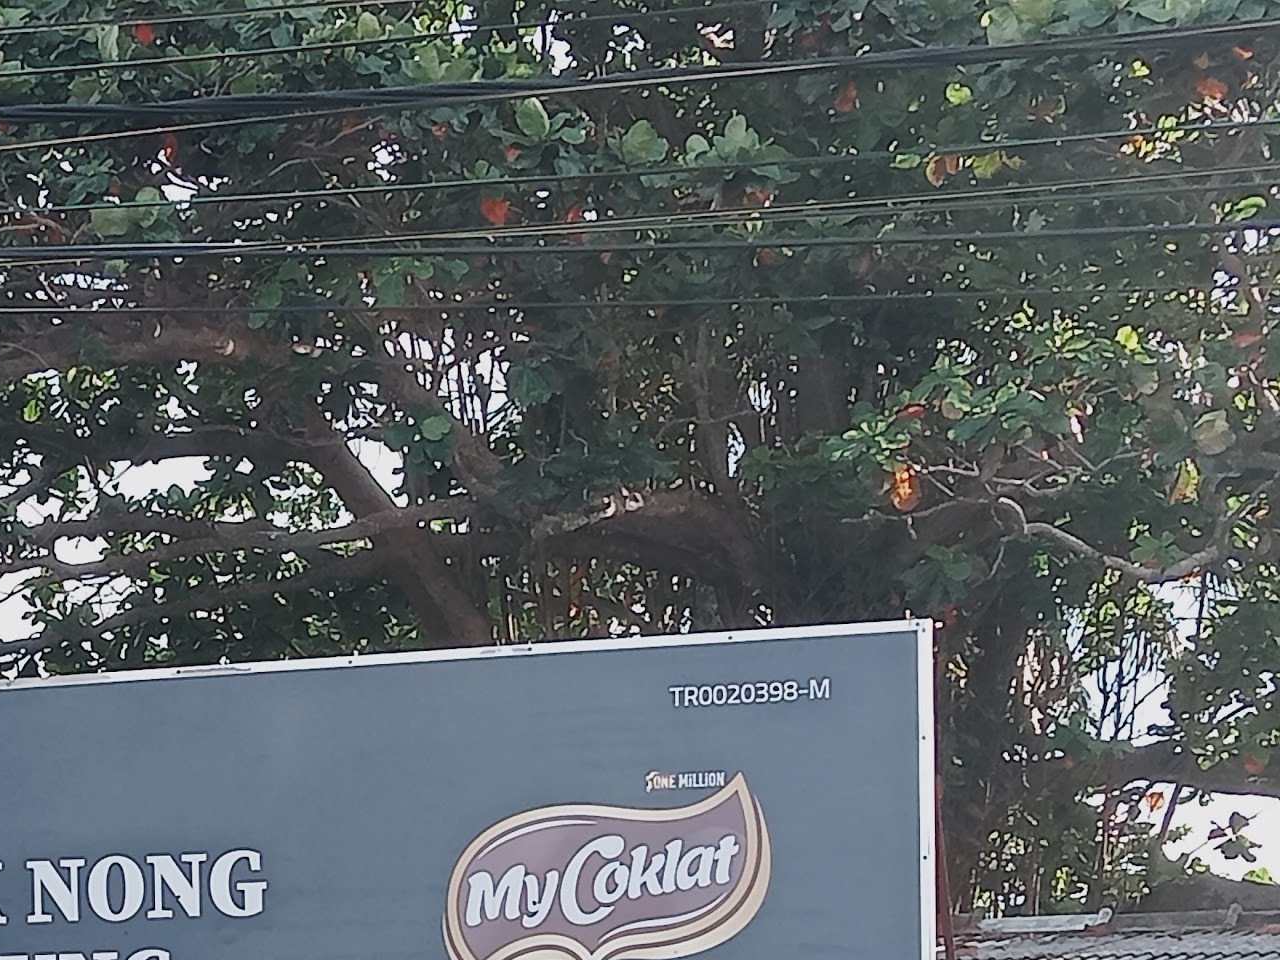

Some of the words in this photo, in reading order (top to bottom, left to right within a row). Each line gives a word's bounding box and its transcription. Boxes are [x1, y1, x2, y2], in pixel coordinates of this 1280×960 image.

[669, 679, 831, 707] TR0020398-M
[26, 849, 268, 926] NONG
[465, 834, 739, 929] MyCoklat
